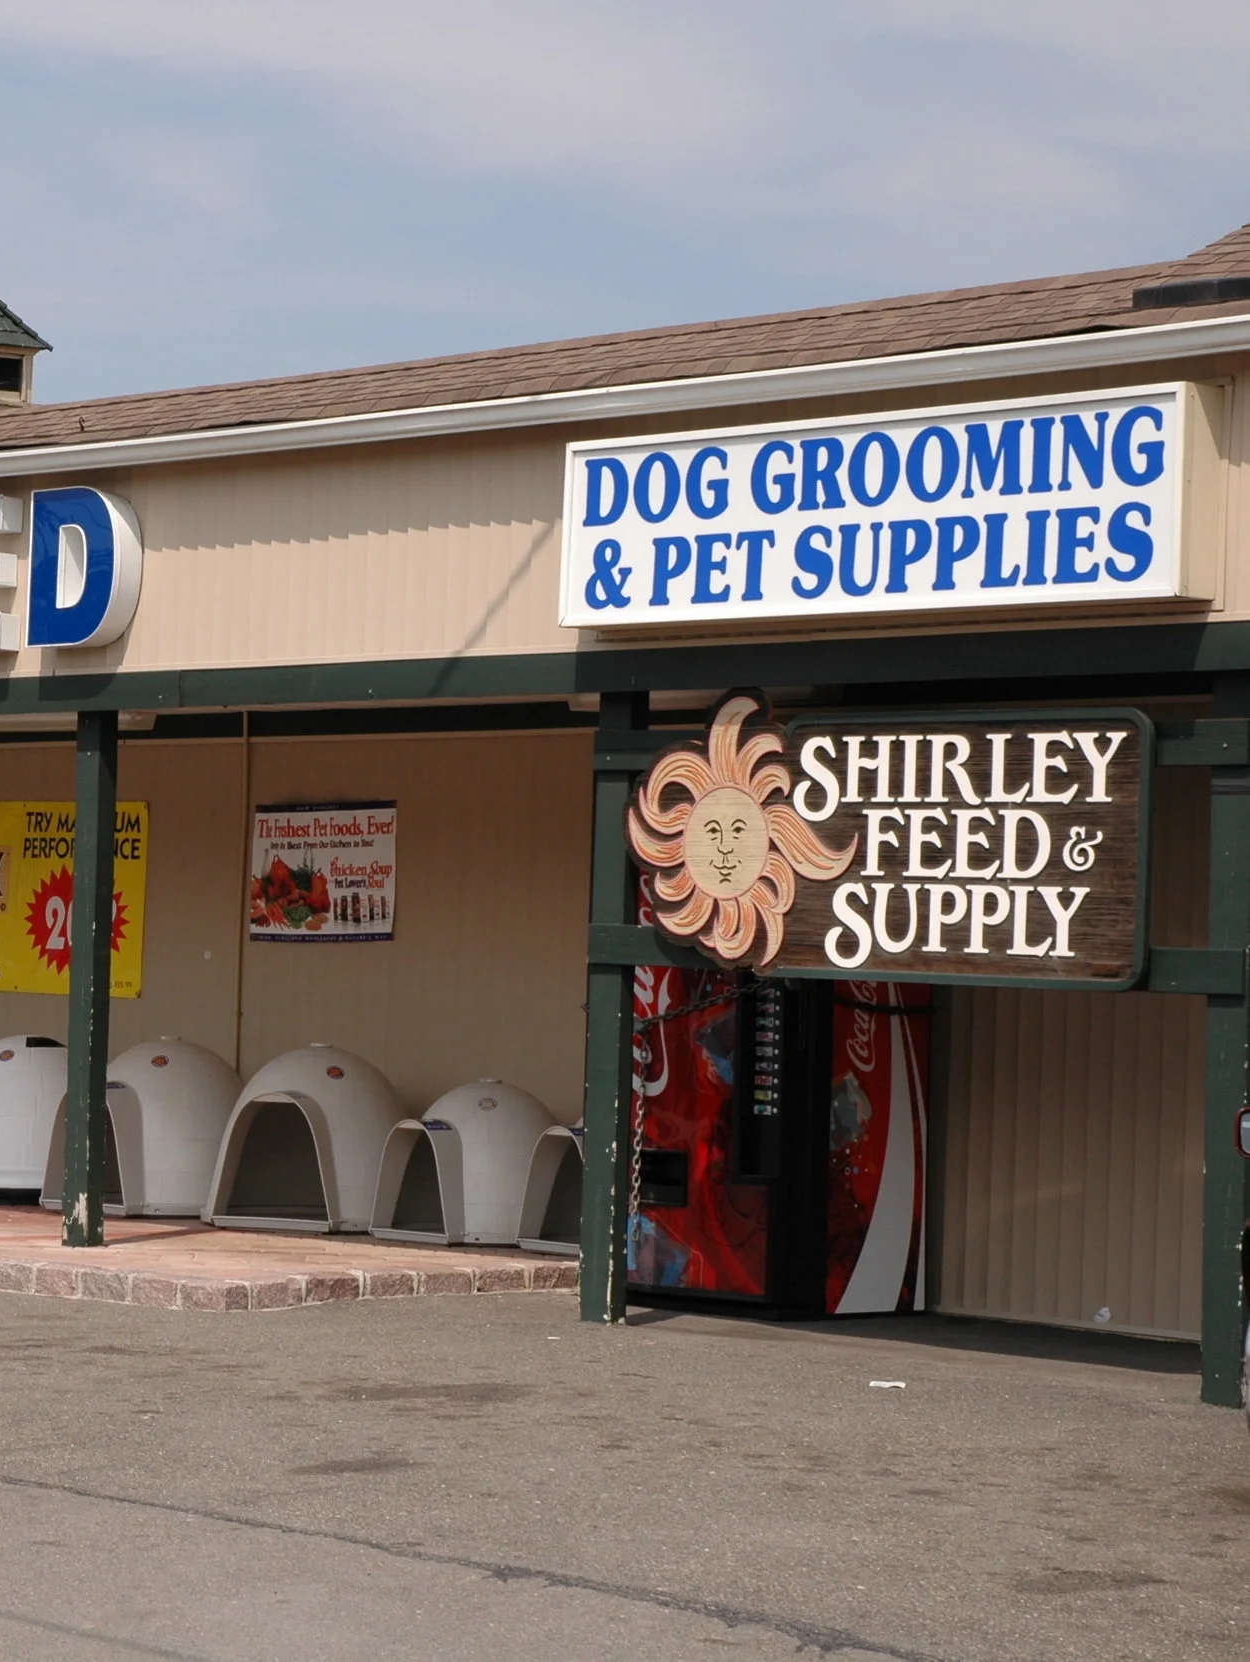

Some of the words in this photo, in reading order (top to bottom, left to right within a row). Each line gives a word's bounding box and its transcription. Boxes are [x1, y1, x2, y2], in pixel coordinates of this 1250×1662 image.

[582, 446, 729, 527] DOG
[750, 405, 1165, 515] GROOMING
[584, 538, 632, 609] &
[649, 529, 775, 606] PET
[791, 502, 1154, 599] SUPPLIES
[793, 730, 1127, 821] SHIRLEY
[26, 812, 53, 833] TRY
[313, 817, 328, 837] Pet
[860, 807, 1051, 880] FEED
[1062, 825, 1103, 871] &
[824, 882, 1090, 968] SUPPLY
